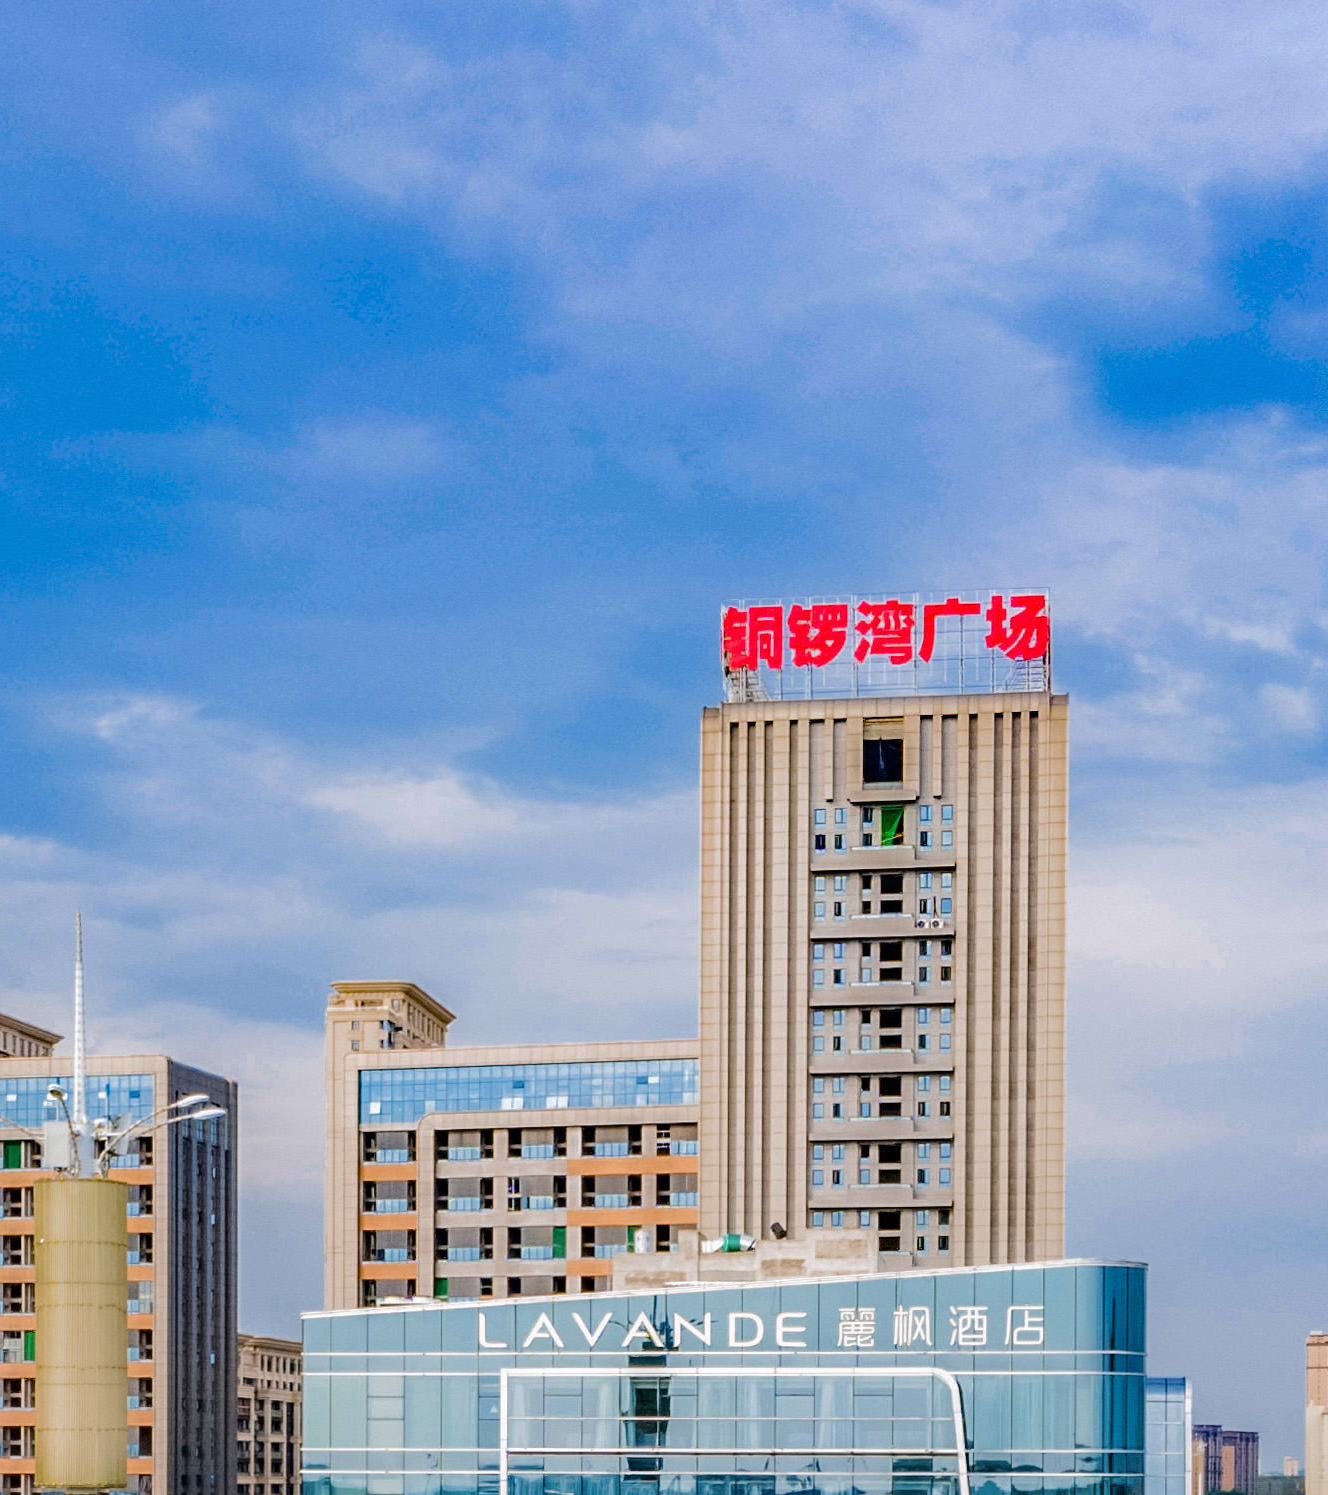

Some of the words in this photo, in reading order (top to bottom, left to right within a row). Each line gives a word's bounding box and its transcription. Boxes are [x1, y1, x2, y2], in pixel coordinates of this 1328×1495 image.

[722, 594, 1050, 671] 铜锣湾广场
[477, 1310, 808, 1349] LAVANDE
